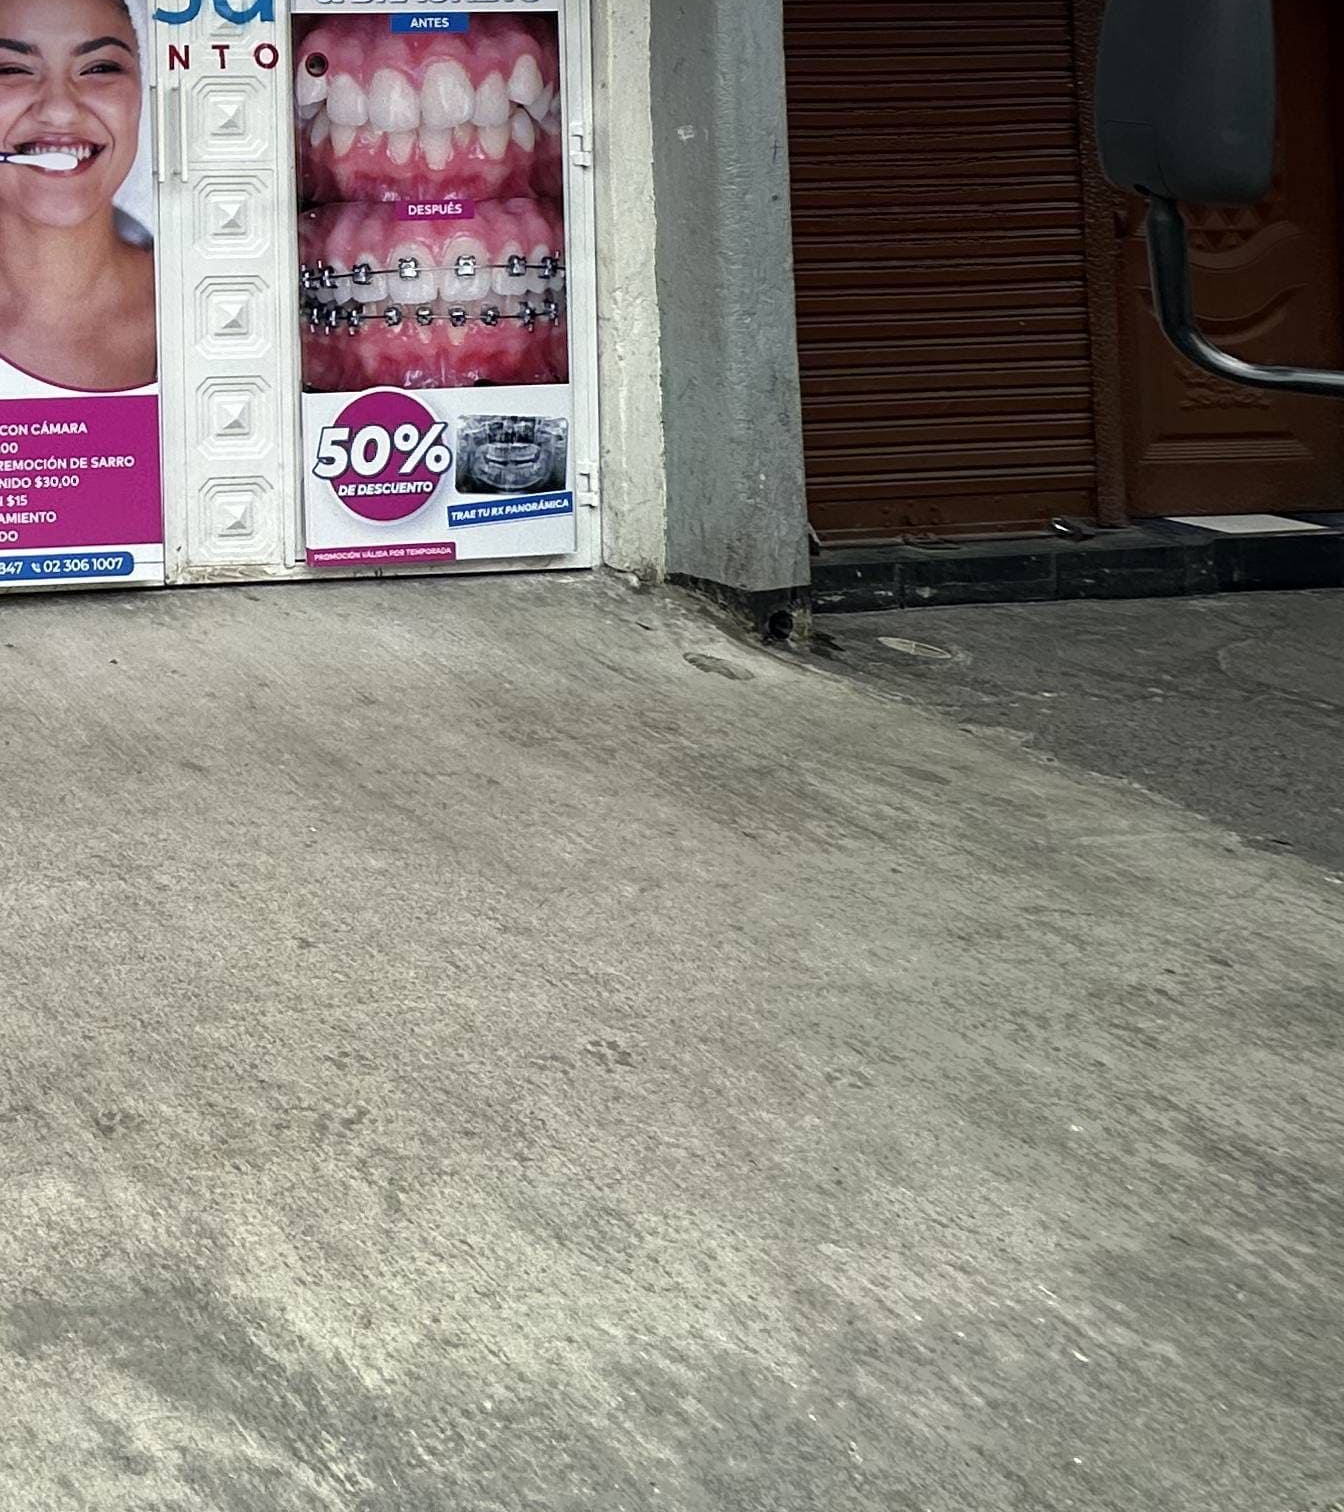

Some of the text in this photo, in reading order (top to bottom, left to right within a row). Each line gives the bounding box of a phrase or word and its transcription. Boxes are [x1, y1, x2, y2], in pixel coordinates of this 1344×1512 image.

[410, 17, 450, 29] ANTES
[408, 203, 463, 216] DESPUÉS
[0, 425, 28, 438] CON
[31, 420, 88, 436] CÁMARA
[312, 421, 453, 479] 50%
[70, 457, 89, 470] DE
[91, 455, 136, 469] SARRO
[338, 481, 433, 496] DE DESCUENTO
[6, 494, 29, 508] $15
[451, 509, 476, 522] TRAE
[43, 560, 60, 573] 02
[62, 559, 89, 572] 306
[91, 557, 123, 571] 1007
